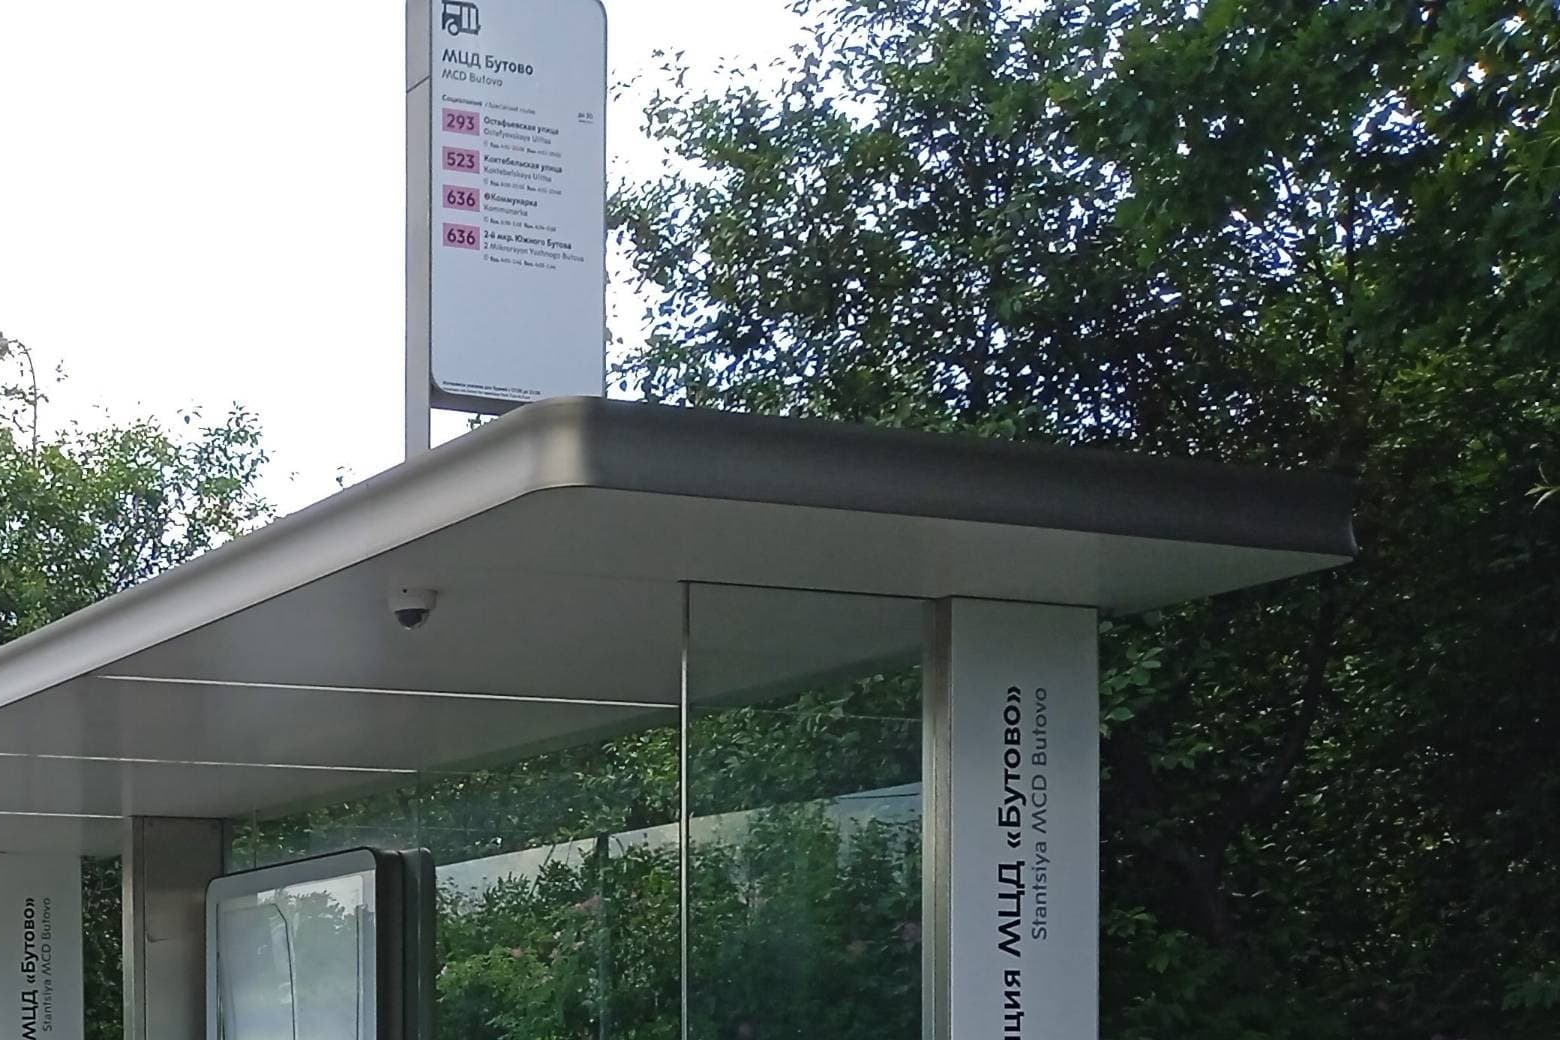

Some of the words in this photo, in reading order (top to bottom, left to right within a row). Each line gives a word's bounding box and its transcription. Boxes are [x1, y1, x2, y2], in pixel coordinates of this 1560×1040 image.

[441, 69, 467, 81] MCD
[442, 48, 481, 69] МЦД
[485, 55, 534, 75] Бутово
[446, 113, 475, 131] 293
[483, 115, 536, 132] Остафьевская
[537, 124, 559, 136] улица
[446, 151, 475, 169] 523
[484, 154, 539, 170] Коктебельская
[541, 163, 562, 174] улица
[446, 189, 476, 207] 636
[491, 193, 538, 208] Коммунарка
[446, 227, 476, 245] 636
[514, 232, 545, 246] Южного
[547, 239, 571, 250] Бутова
[1032, 687, 1048, 767] Butovo
[998, 686, 1027, 850] «Бутово»
[1032, 775, 1048, 835] MCD
[1032, 841, 1050, 941] Stantsiya
[41, 897, 52, 940] Butovo
[998, 861, 1025, 957] МЦД
[21, 898, 39, 984] «Бутово»
[41, 943, 52, 976] MCD
[21, 990, 39, 1040] МЦД
